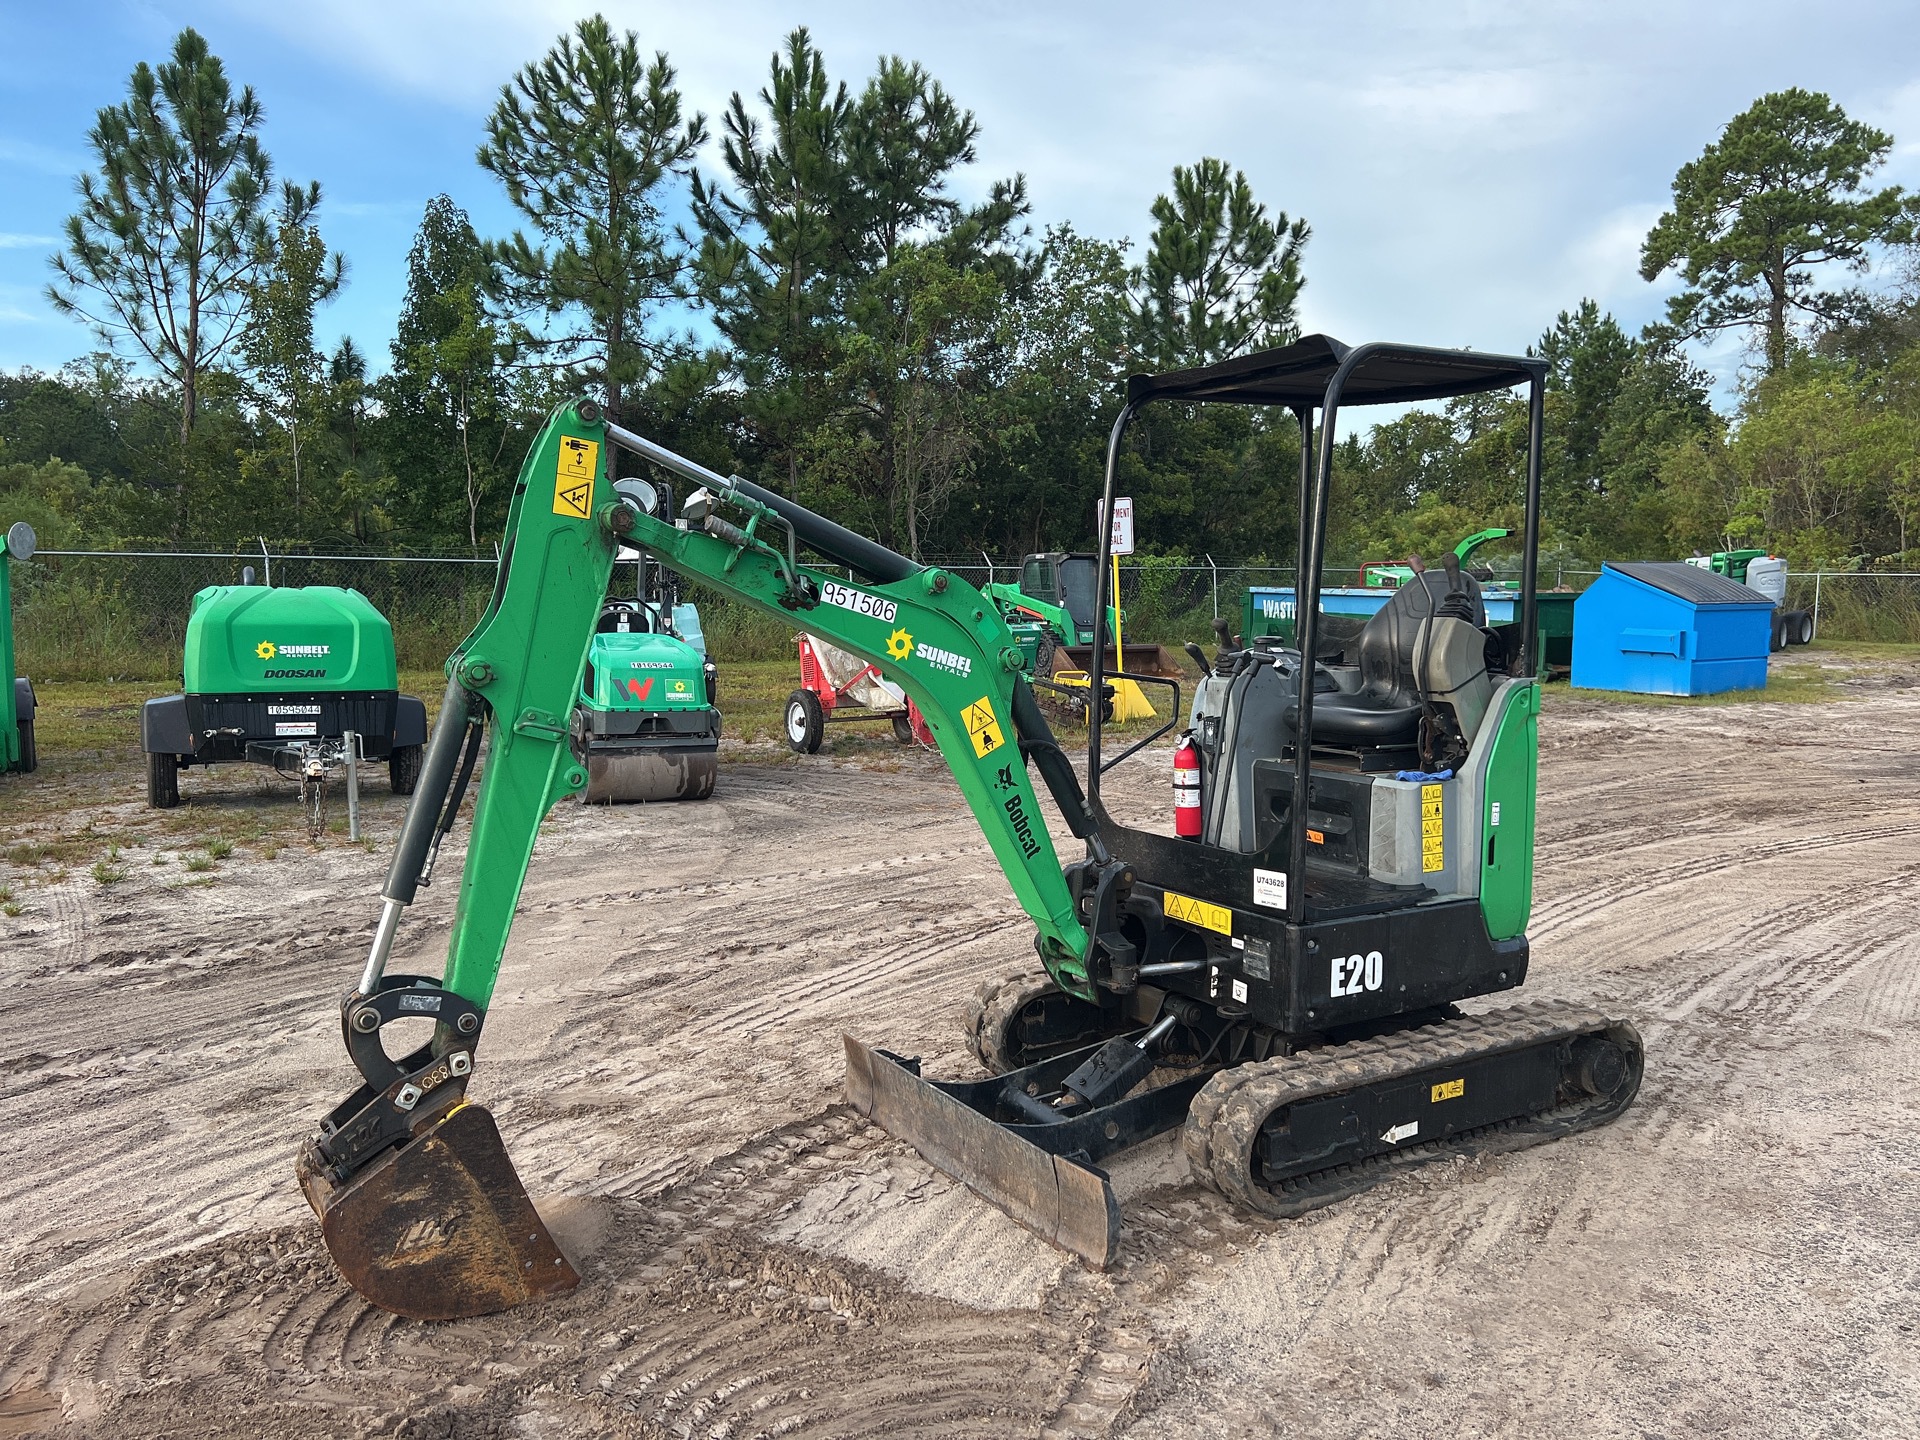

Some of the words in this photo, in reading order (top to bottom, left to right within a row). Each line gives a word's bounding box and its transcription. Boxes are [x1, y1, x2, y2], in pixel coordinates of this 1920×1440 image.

[1113, 521, 1122, 532] OR
[824, 582, 897, 621] 951506
[279, 645, 329, 654] SUNBELT
[263, 669, 327, 679] DOOSAN
[269, 705, 321, 714] 10595044
[1004, 793, 1042, 861] Bobcat
[1256, 876, 1285, 888] U743628
[1330, 950, 1383, 998] E20
